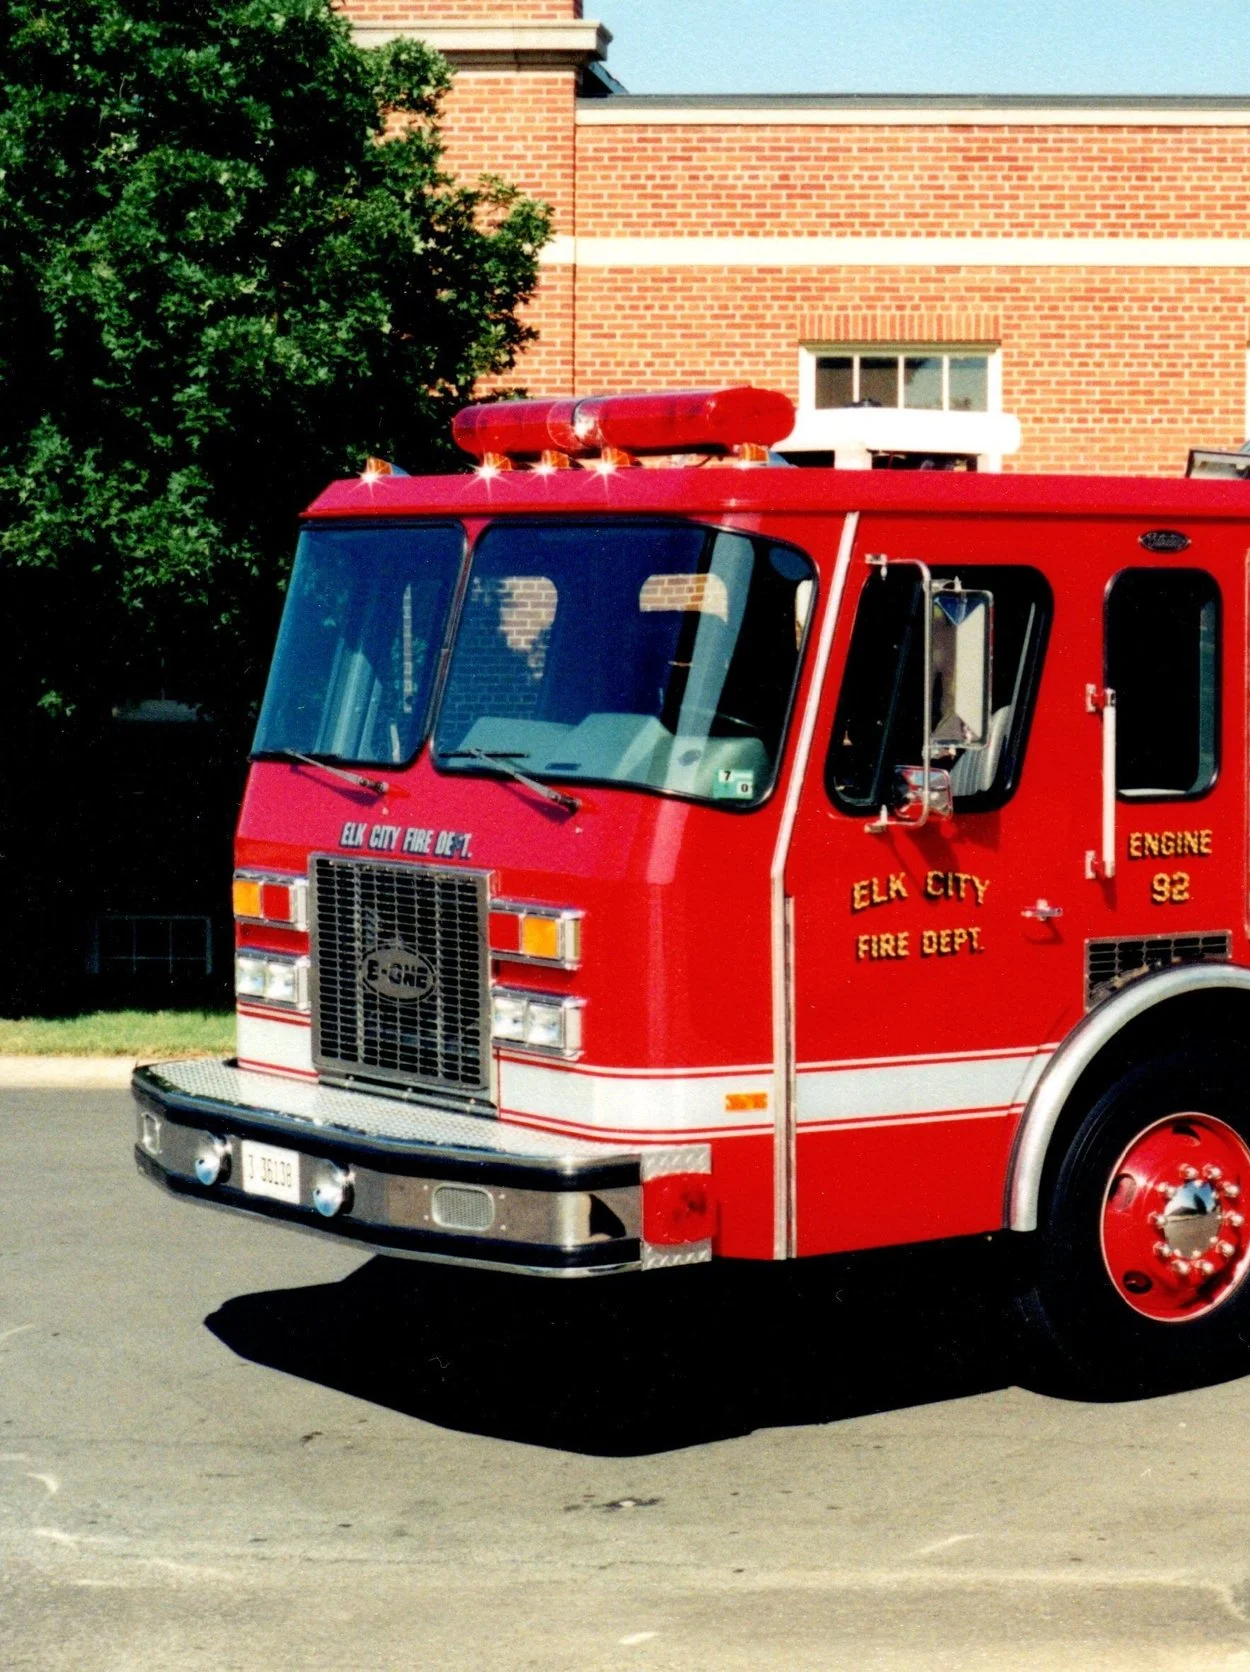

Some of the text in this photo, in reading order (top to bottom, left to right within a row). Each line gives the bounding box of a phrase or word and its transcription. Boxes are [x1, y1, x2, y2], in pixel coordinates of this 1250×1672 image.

[723, 770, 732, 782] 7
[340, 821, 473, 859] ELK CITY FIRE DET.
[1129, 829, 1213, 858] ENGINE
[852, 870, 991, 911] ELK CITY
[1152, 871, 1190, 903] 92
[857, 927, 986, 960] FIRE DEPT.
